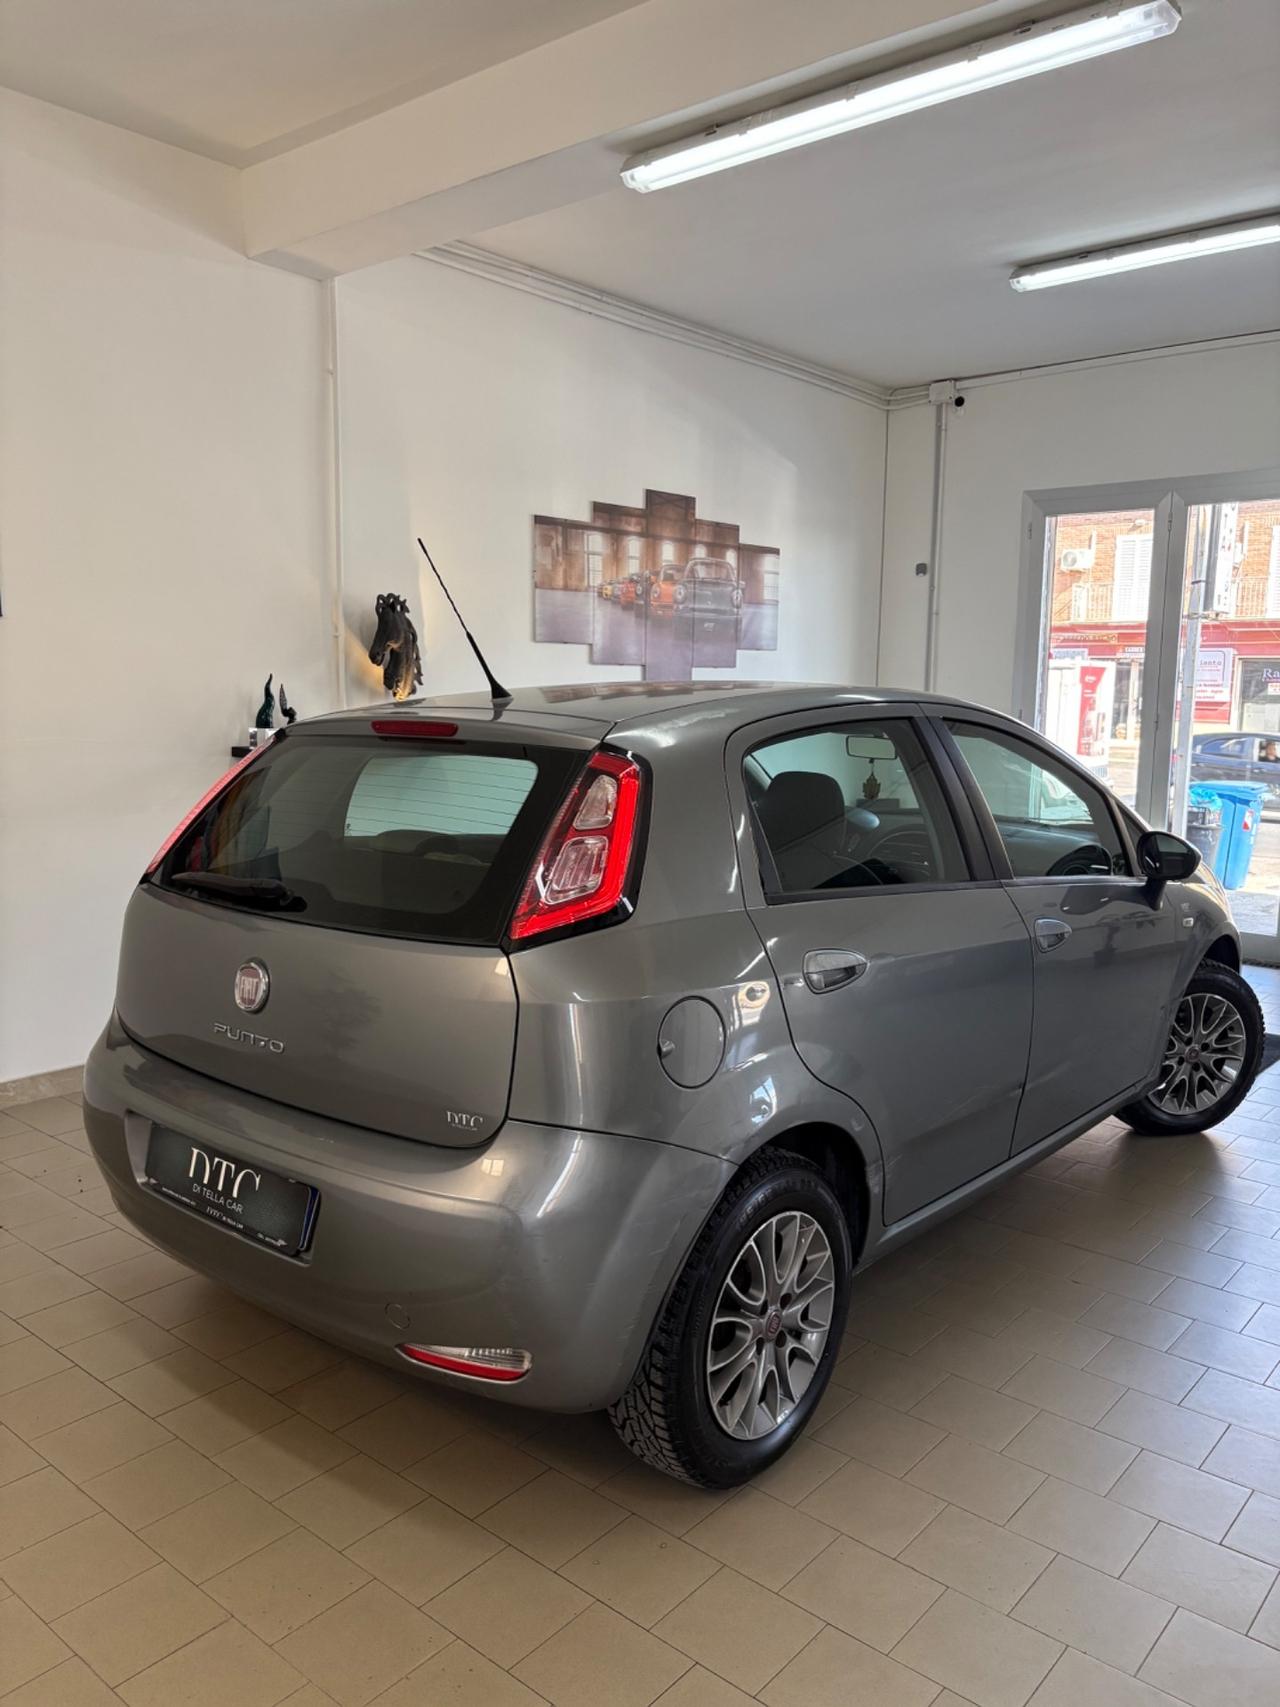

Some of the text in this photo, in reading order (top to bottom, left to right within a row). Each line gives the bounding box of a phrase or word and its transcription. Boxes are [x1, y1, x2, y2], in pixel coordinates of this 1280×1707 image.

[214, 1022, 284, 1053] PUNTO
[202, 1186, 225, 1206] TELLA
[226, 1199, 244, 1215] CAR
